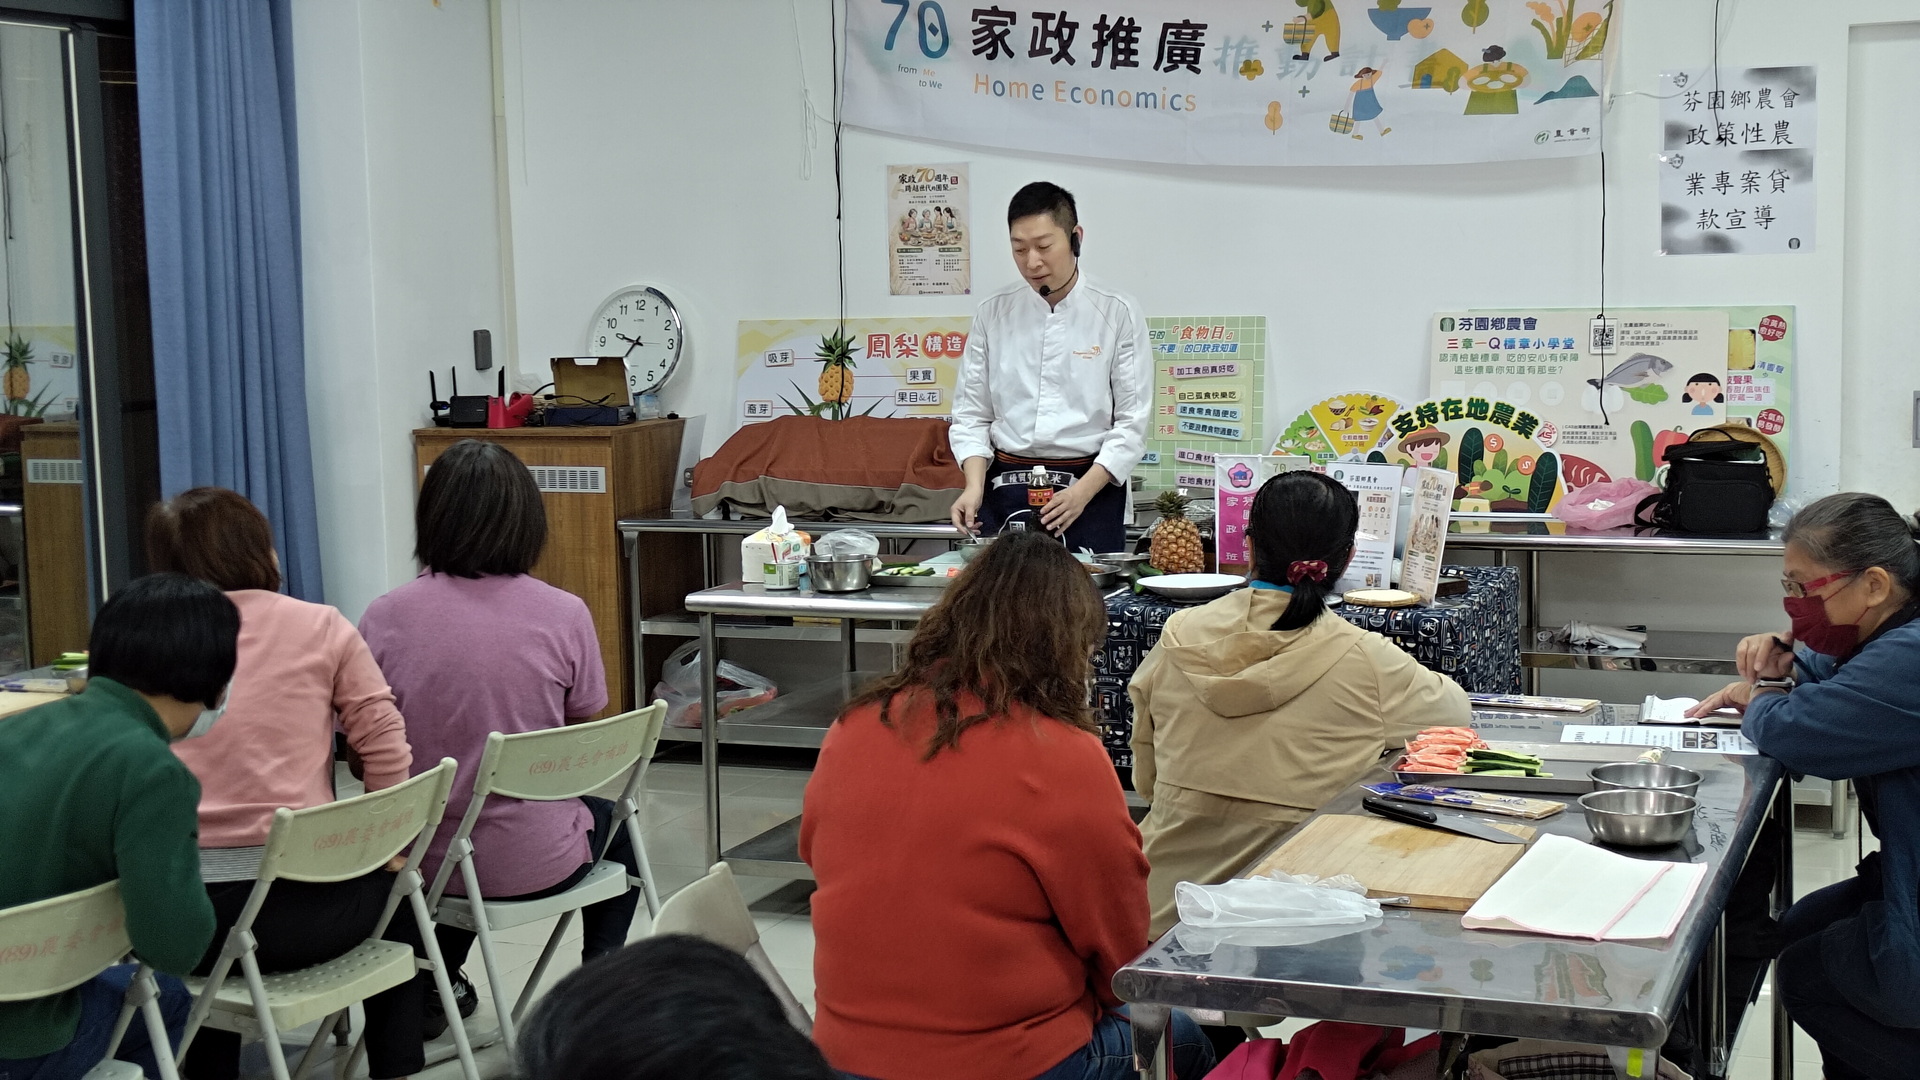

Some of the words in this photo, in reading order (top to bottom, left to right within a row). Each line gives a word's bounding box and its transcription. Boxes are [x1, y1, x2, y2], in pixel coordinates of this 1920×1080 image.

[881, 0, 950, 59] 70
[970, 4, 1209, 75] 家政推廣
[898, 64, 918, 75] from
[922, 68, 936, 77] Me
[918, 79, 928, 87] to
[929, 80, 943, 89] We
[974, 73, 1045, 100] Home
[1054, 80, 1197, 111] Economics
[1682, 87, 1801, 112] 芬園鄉農會
[1685, 119, 1794, 147] 政策性農
[1684, 168, 1791, 196] 業專案貸
[1696, 205, 1777, 230] 款宣導
[620, 304, 628, 315] 11
[635, 299, 646, 311] 12
[654, 305, 660, 316] 1
[607, 317, 617, 329] 10
[664, 319, 672, 331] 2
[1458, 316, 1538, 331] 芬園鄉農會
[599, 335, 606, 347] 9
[667, 338, 674, 350] 3
[866, 333, 962, 359] 鳳梨構造
[659, 358, 667, 369] 4
[767, 351, 790, 364] 吸芽
[646, 370, 654, 382] 5
[909, 370, 932, 381] 果實
[1391, 397, 1539, 440] 支持在地農業
[1158, 425, 1175, 435] 不要
[1179, 475, 1216, 486] 在地食材
